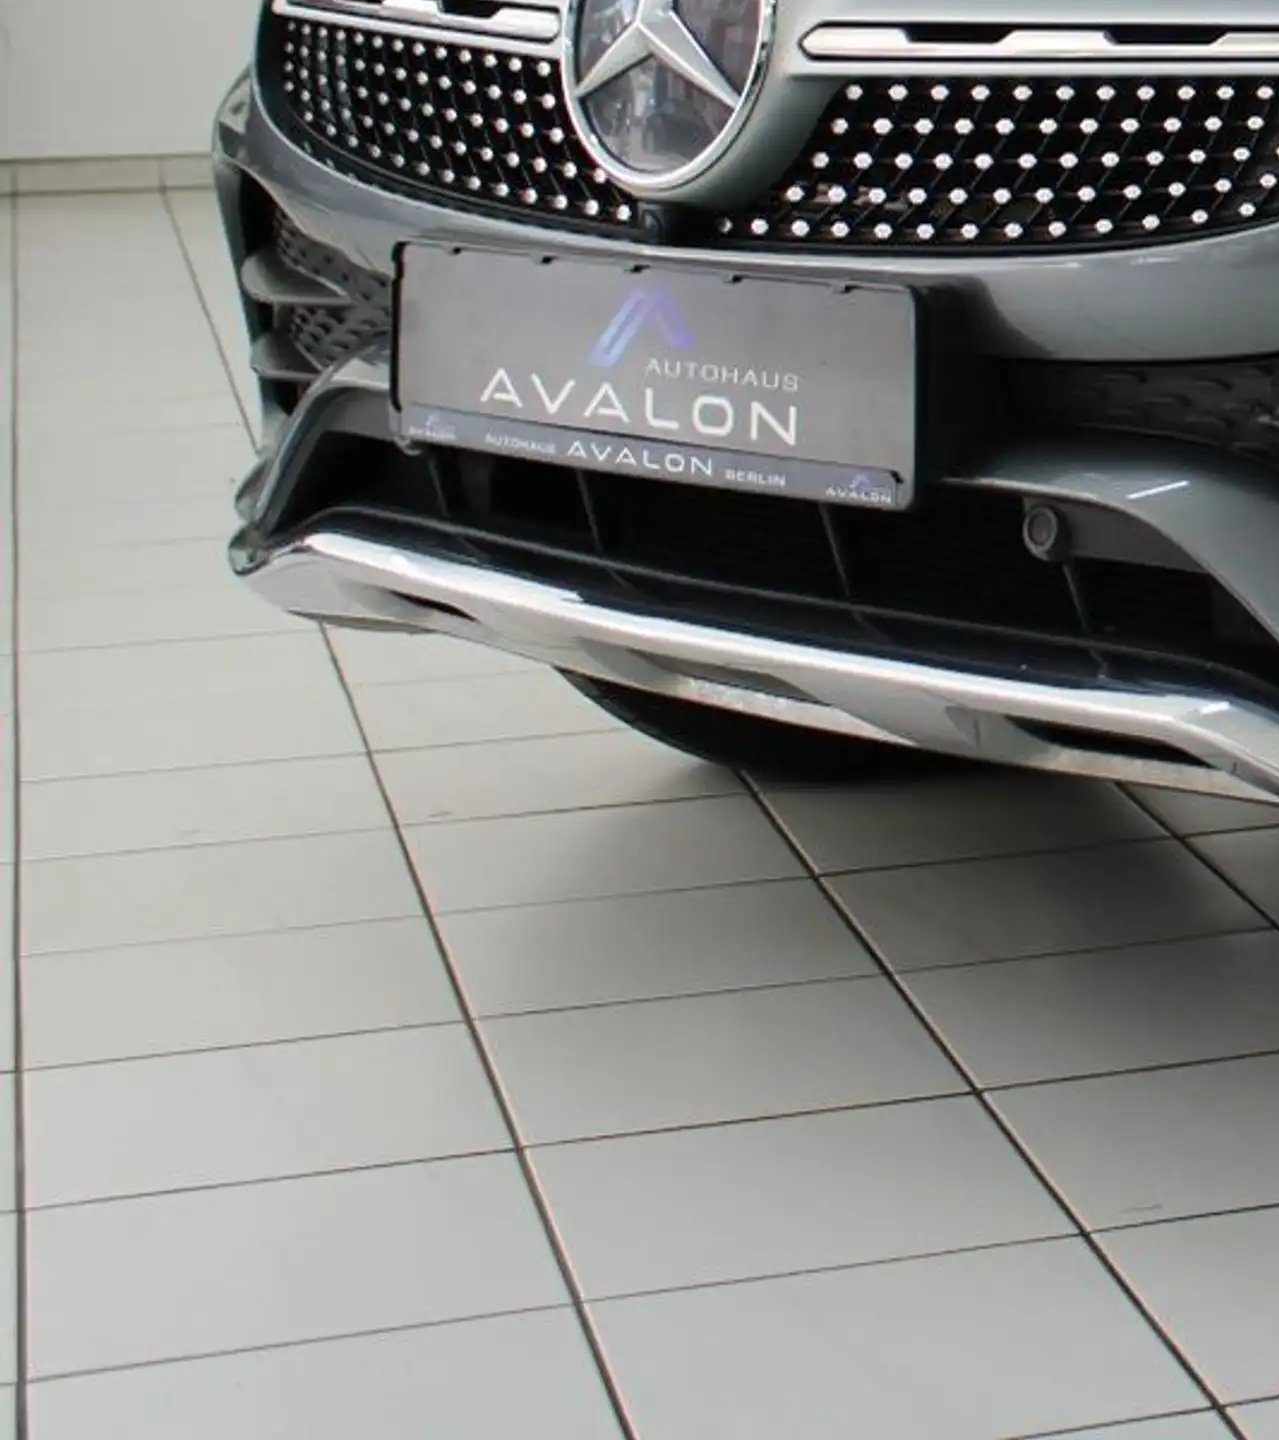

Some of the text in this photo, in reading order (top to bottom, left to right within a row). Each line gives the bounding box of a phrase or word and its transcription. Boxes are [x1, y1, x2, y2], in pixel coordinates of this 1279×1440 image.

[645, 358, 800, 392] AUTOHAUS
[480, 367, 797, 447] AVALON
[566, 439, 713, 478] AVALON
[724, 468, 786, 488] BERLIN
